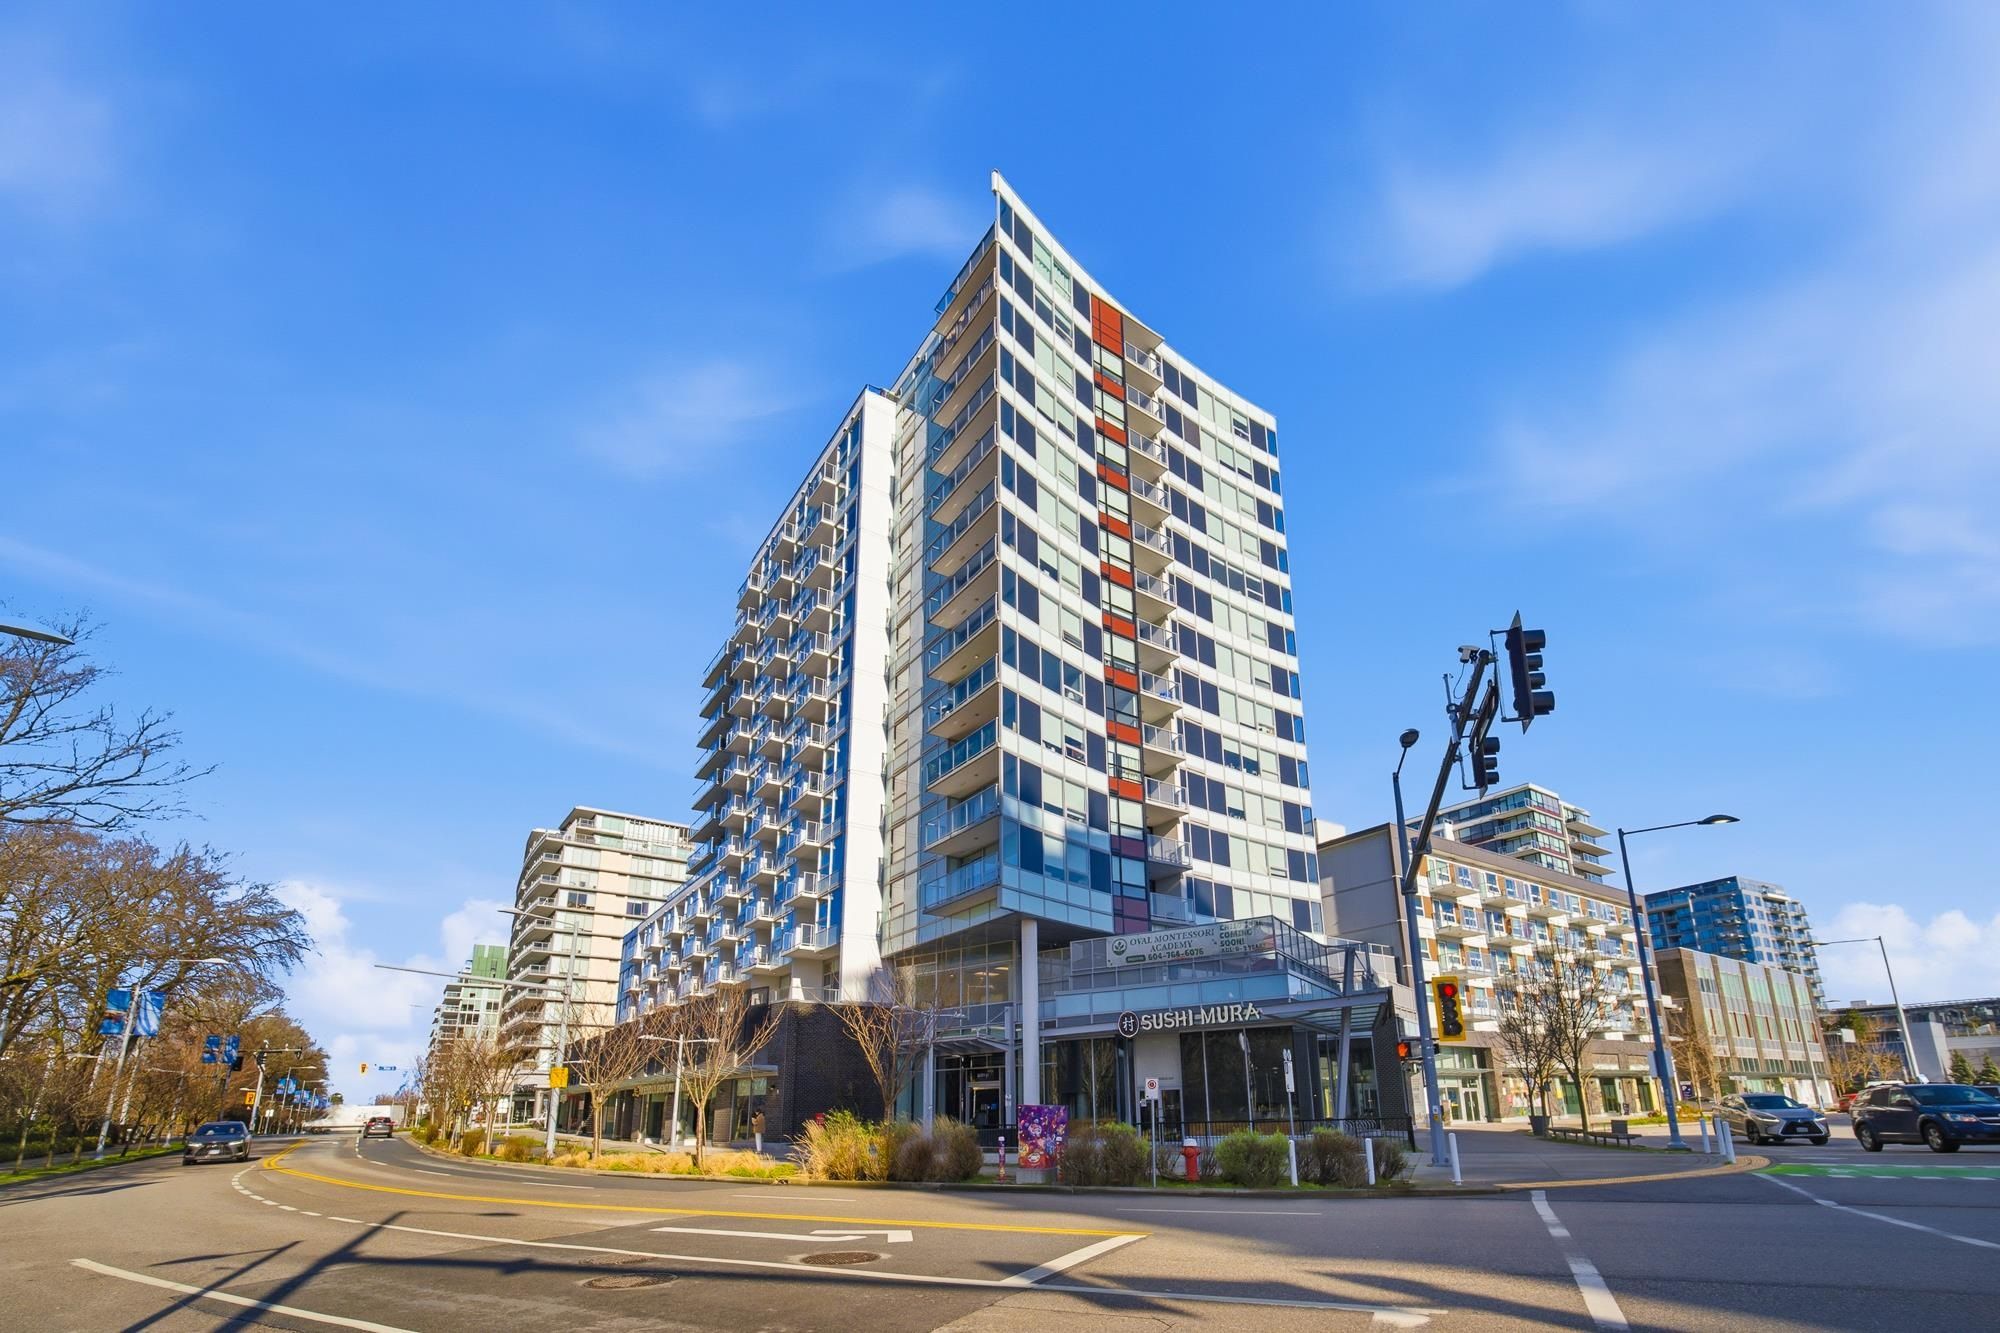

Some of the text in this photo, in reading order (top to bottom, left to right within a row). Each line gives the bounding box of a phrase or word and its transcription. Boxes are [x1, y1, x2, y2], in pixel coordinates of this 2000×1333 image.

[1130, 928, 1215, 946] OVAL MONTESSORI
[1219, 928, 1253, 939] COMING
[1150, 939, 1193, 953] ACADEMY
[1220, 937, 1245, 947] SOON!
[1122, 1016, 1135, 1032] 村
[1140, 1002, 1260, 1031] SUSHI MURA
